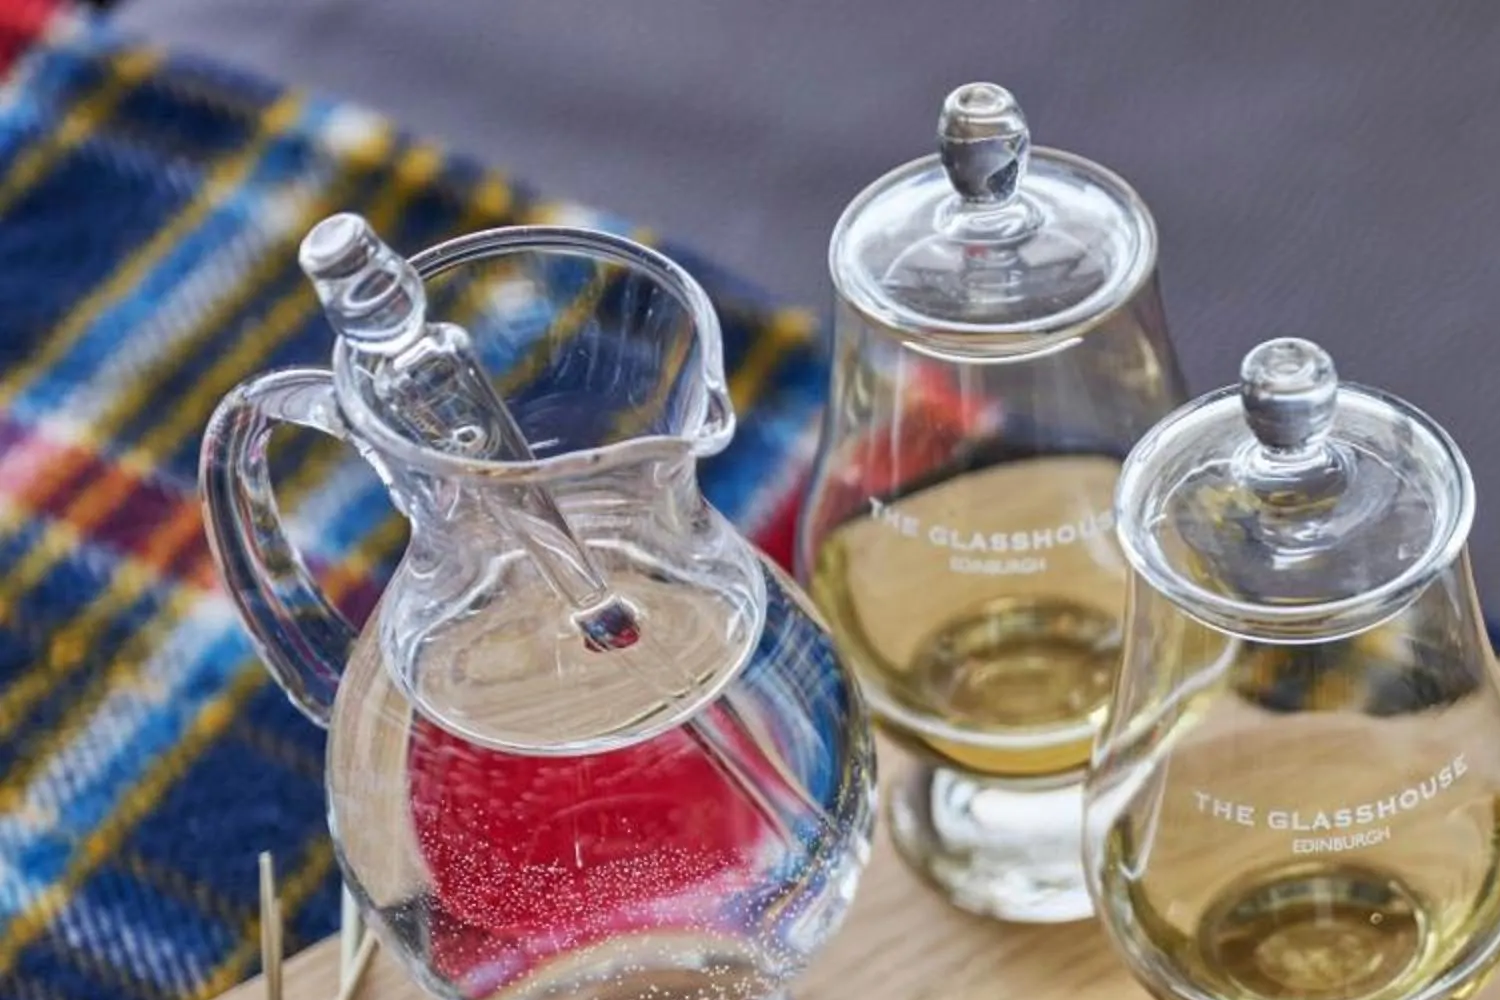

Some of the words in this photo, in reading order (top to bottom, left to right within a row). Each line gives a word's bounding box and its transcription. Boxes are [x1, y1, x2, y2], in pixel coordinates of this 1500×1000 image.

[868, 496, 918, 536] THE
[928, 508, 1115, 553] GLASSHOUS
[1194, 791, 1254, 826] THE
[1267, 752, 1470, 832] GLASSHOUSE
[1292, 827, 1391, 853] EDINBURGH
